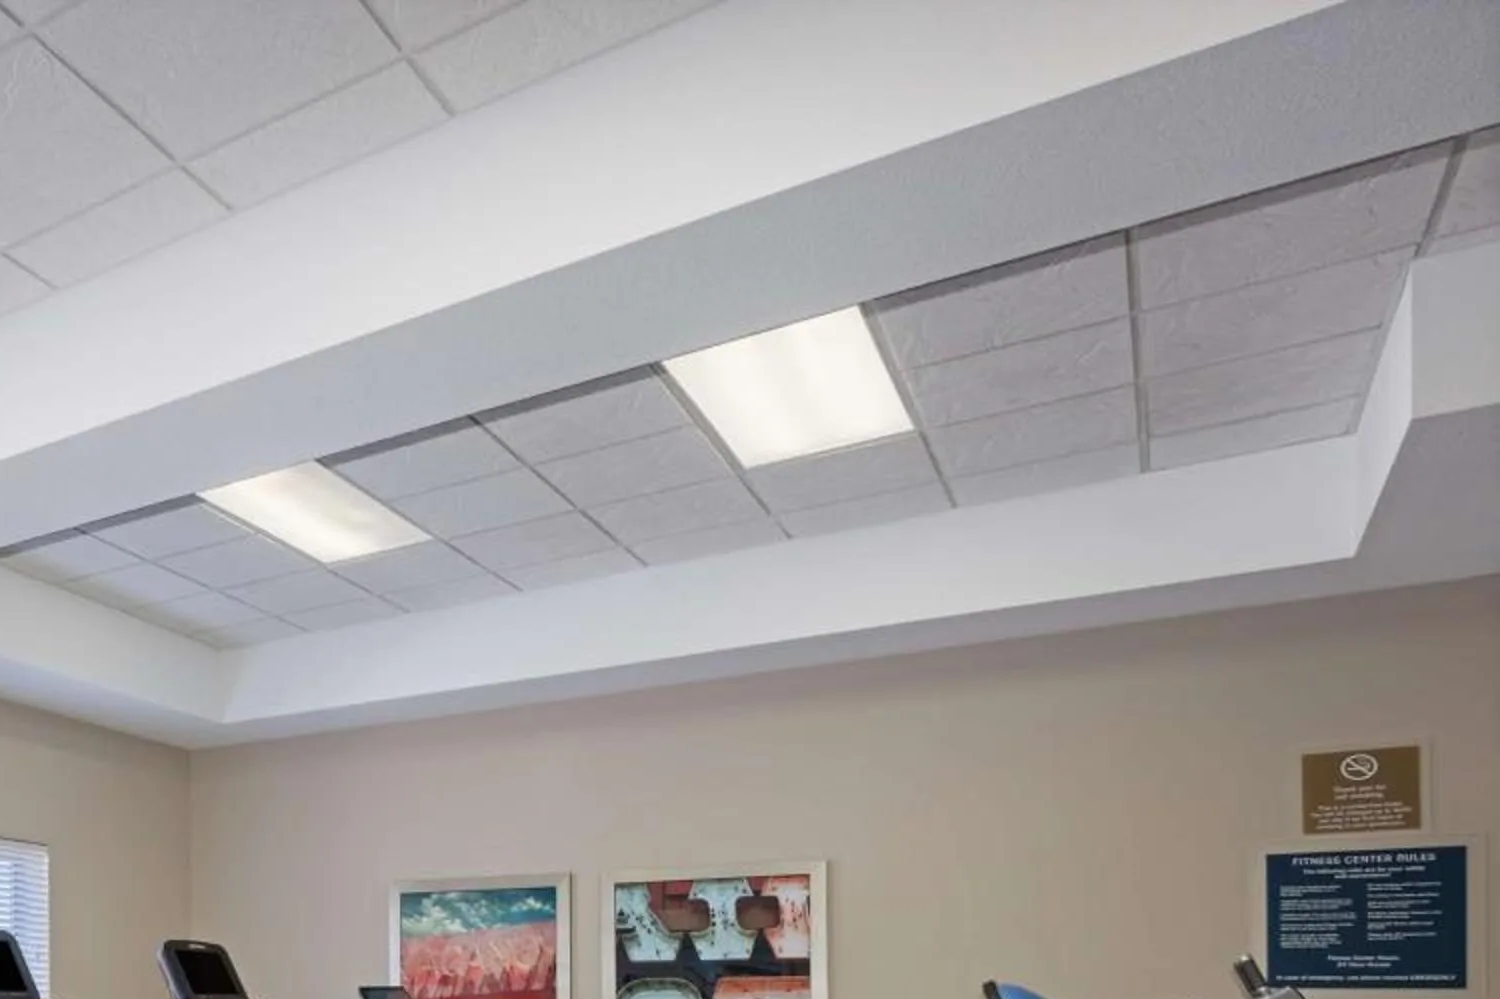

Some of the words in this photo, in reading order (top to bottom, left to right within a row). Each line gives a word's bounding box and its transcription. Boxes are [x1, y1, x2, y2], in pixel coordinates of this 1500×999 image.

[1291, 856, 1341, 866] FITNESS
[1344, 854, 1393, 865] CENTER
[1396, 852, 1438, 863] RULES
